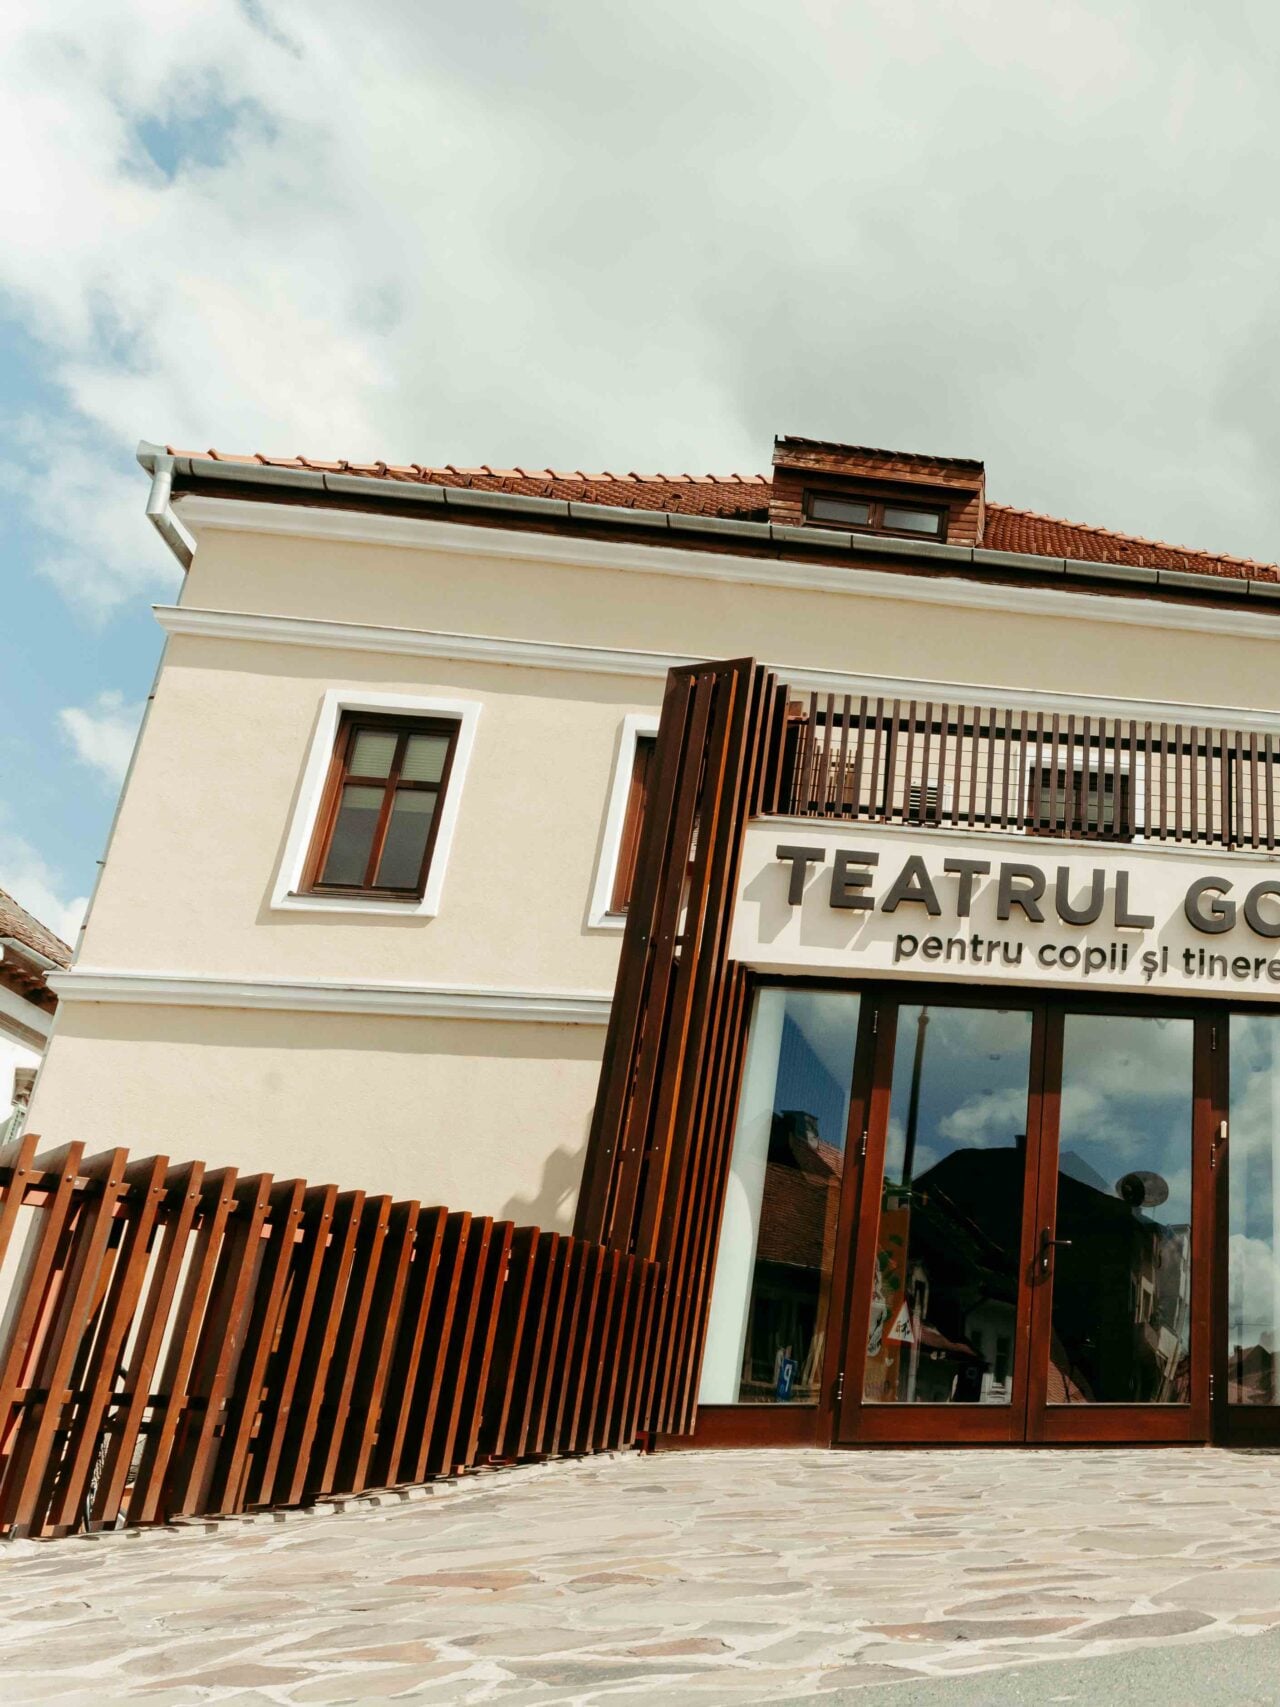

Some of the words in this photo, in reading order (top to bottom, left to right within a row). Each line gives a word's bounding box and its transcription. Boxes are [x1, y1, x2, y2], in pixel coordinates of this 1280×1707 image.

[776, 844, 1155, 929] TEATRUL
[894, 933, 1023, 964] pentru
[1037, 942, 1128, 975] copii
[1142, 945, 1169, 982] și
